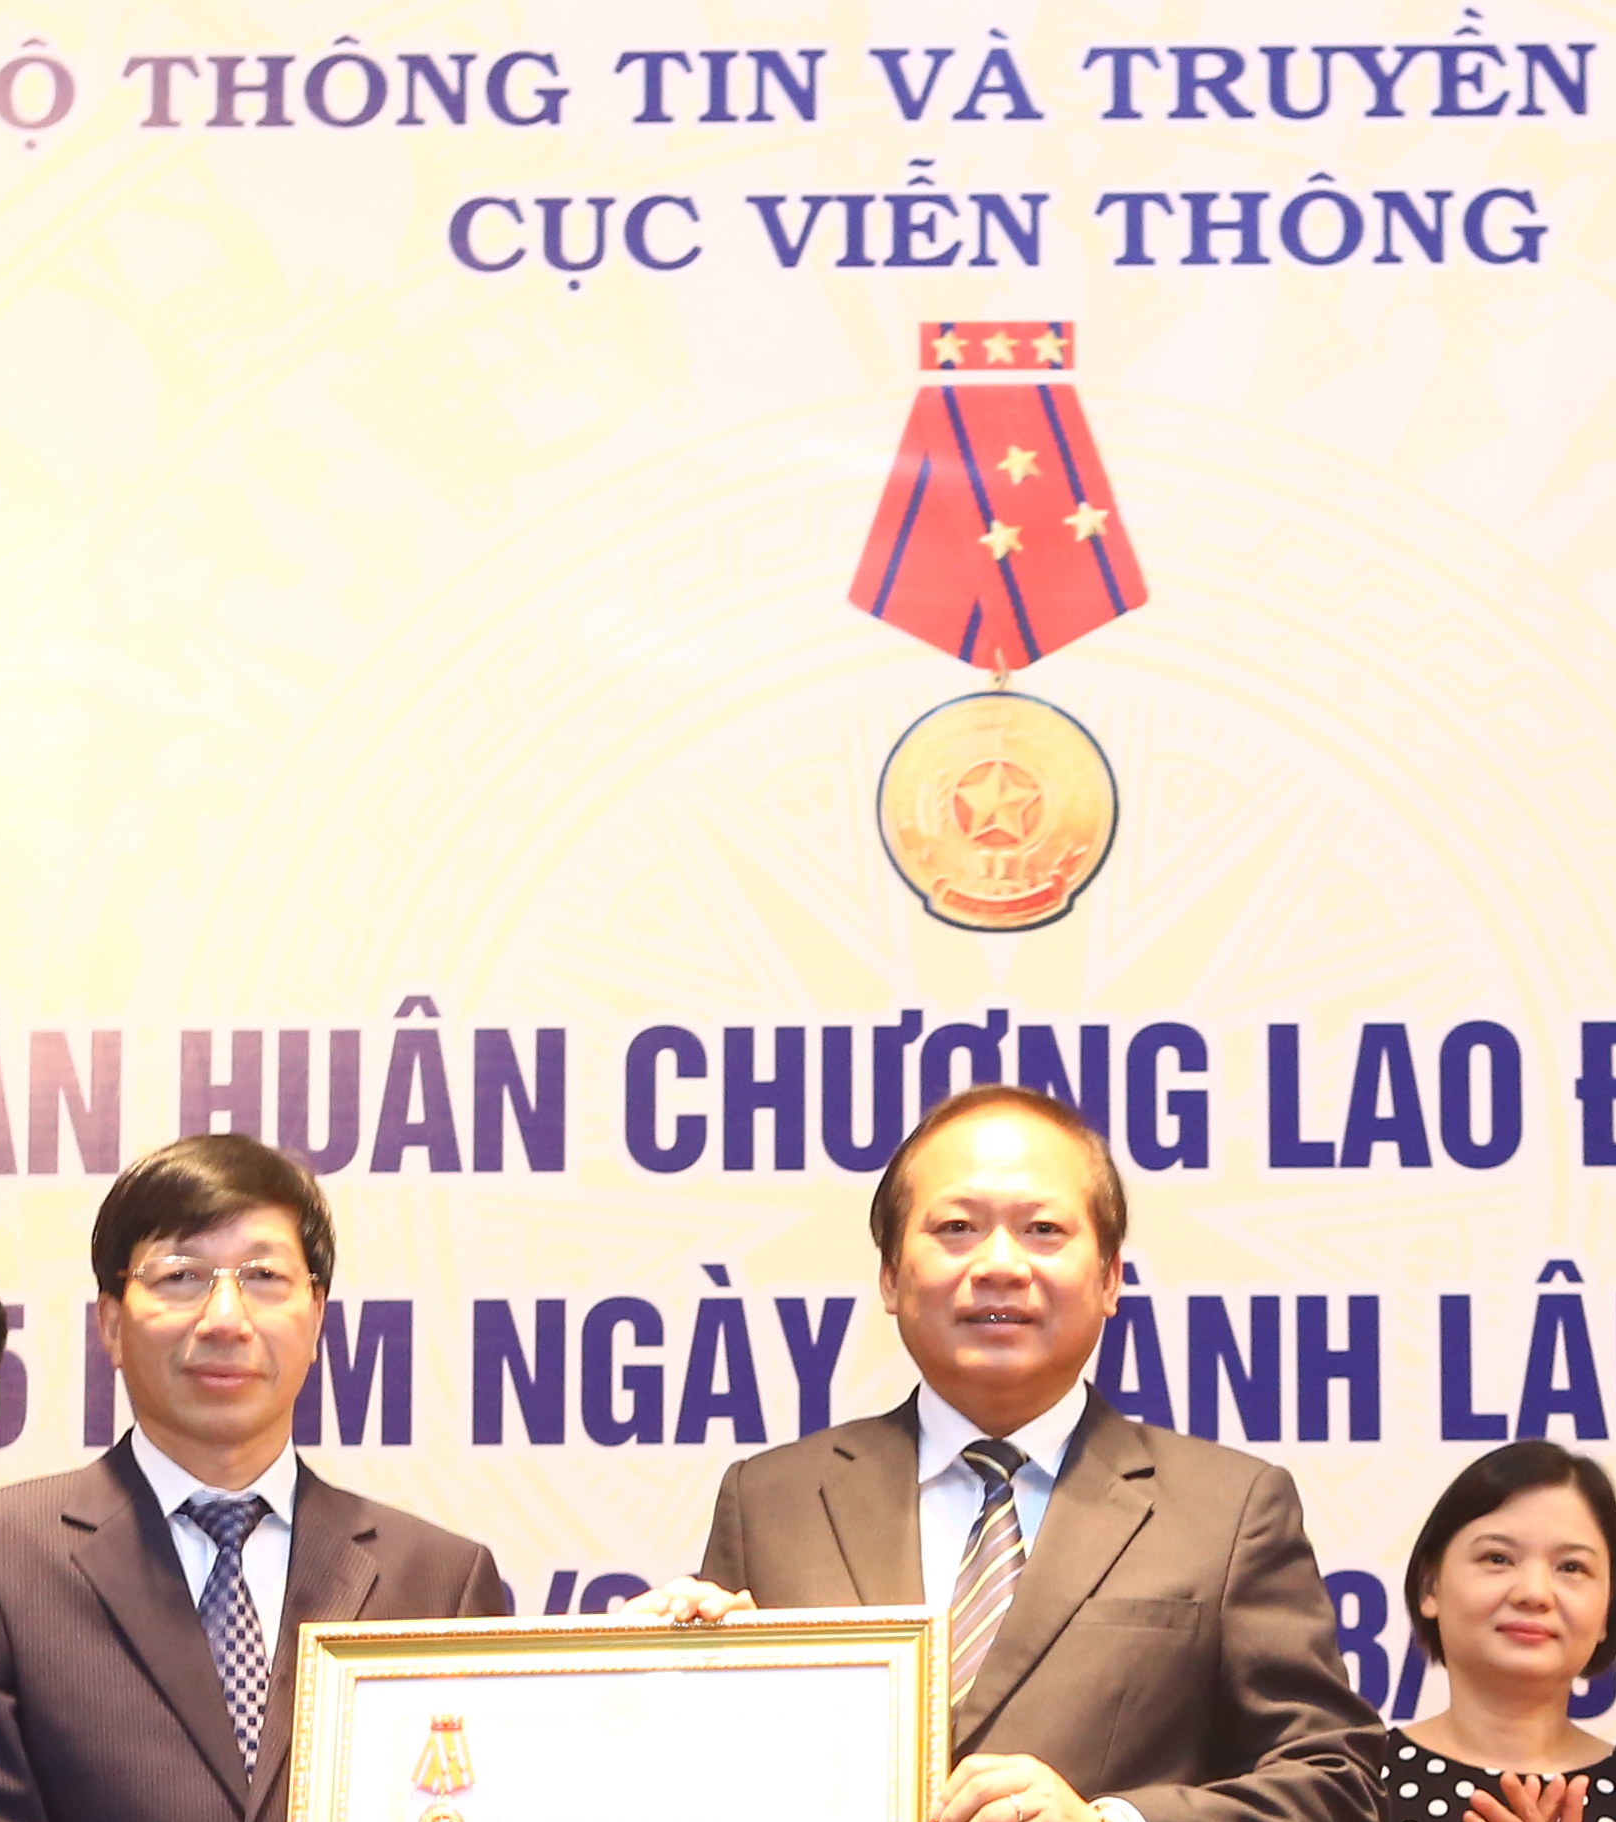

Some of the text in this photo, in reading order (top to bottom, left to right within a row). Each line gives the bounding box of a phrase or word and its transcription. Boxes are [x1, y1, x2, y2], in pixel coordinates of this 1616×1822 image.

[121, 34, 572, 130] THÔNG
[612, 48, 827, 126] TIN
[866, 27, 1045, 124] VÀ
[1080, 7, 1599, 123] TRUYỀN
[447, 154, 1550, 292] CỤC VIỄN THÔNG
[180, 995, 568, 1176] HUÂN
[622, 1007, 1212, 1177] CHƯƠNG
[1265, 1020, 1526, 1173] LAO
[470, 1262, 858, 1450] NGÀY
[1091, 1261, 1384, 1445] ÀNH
